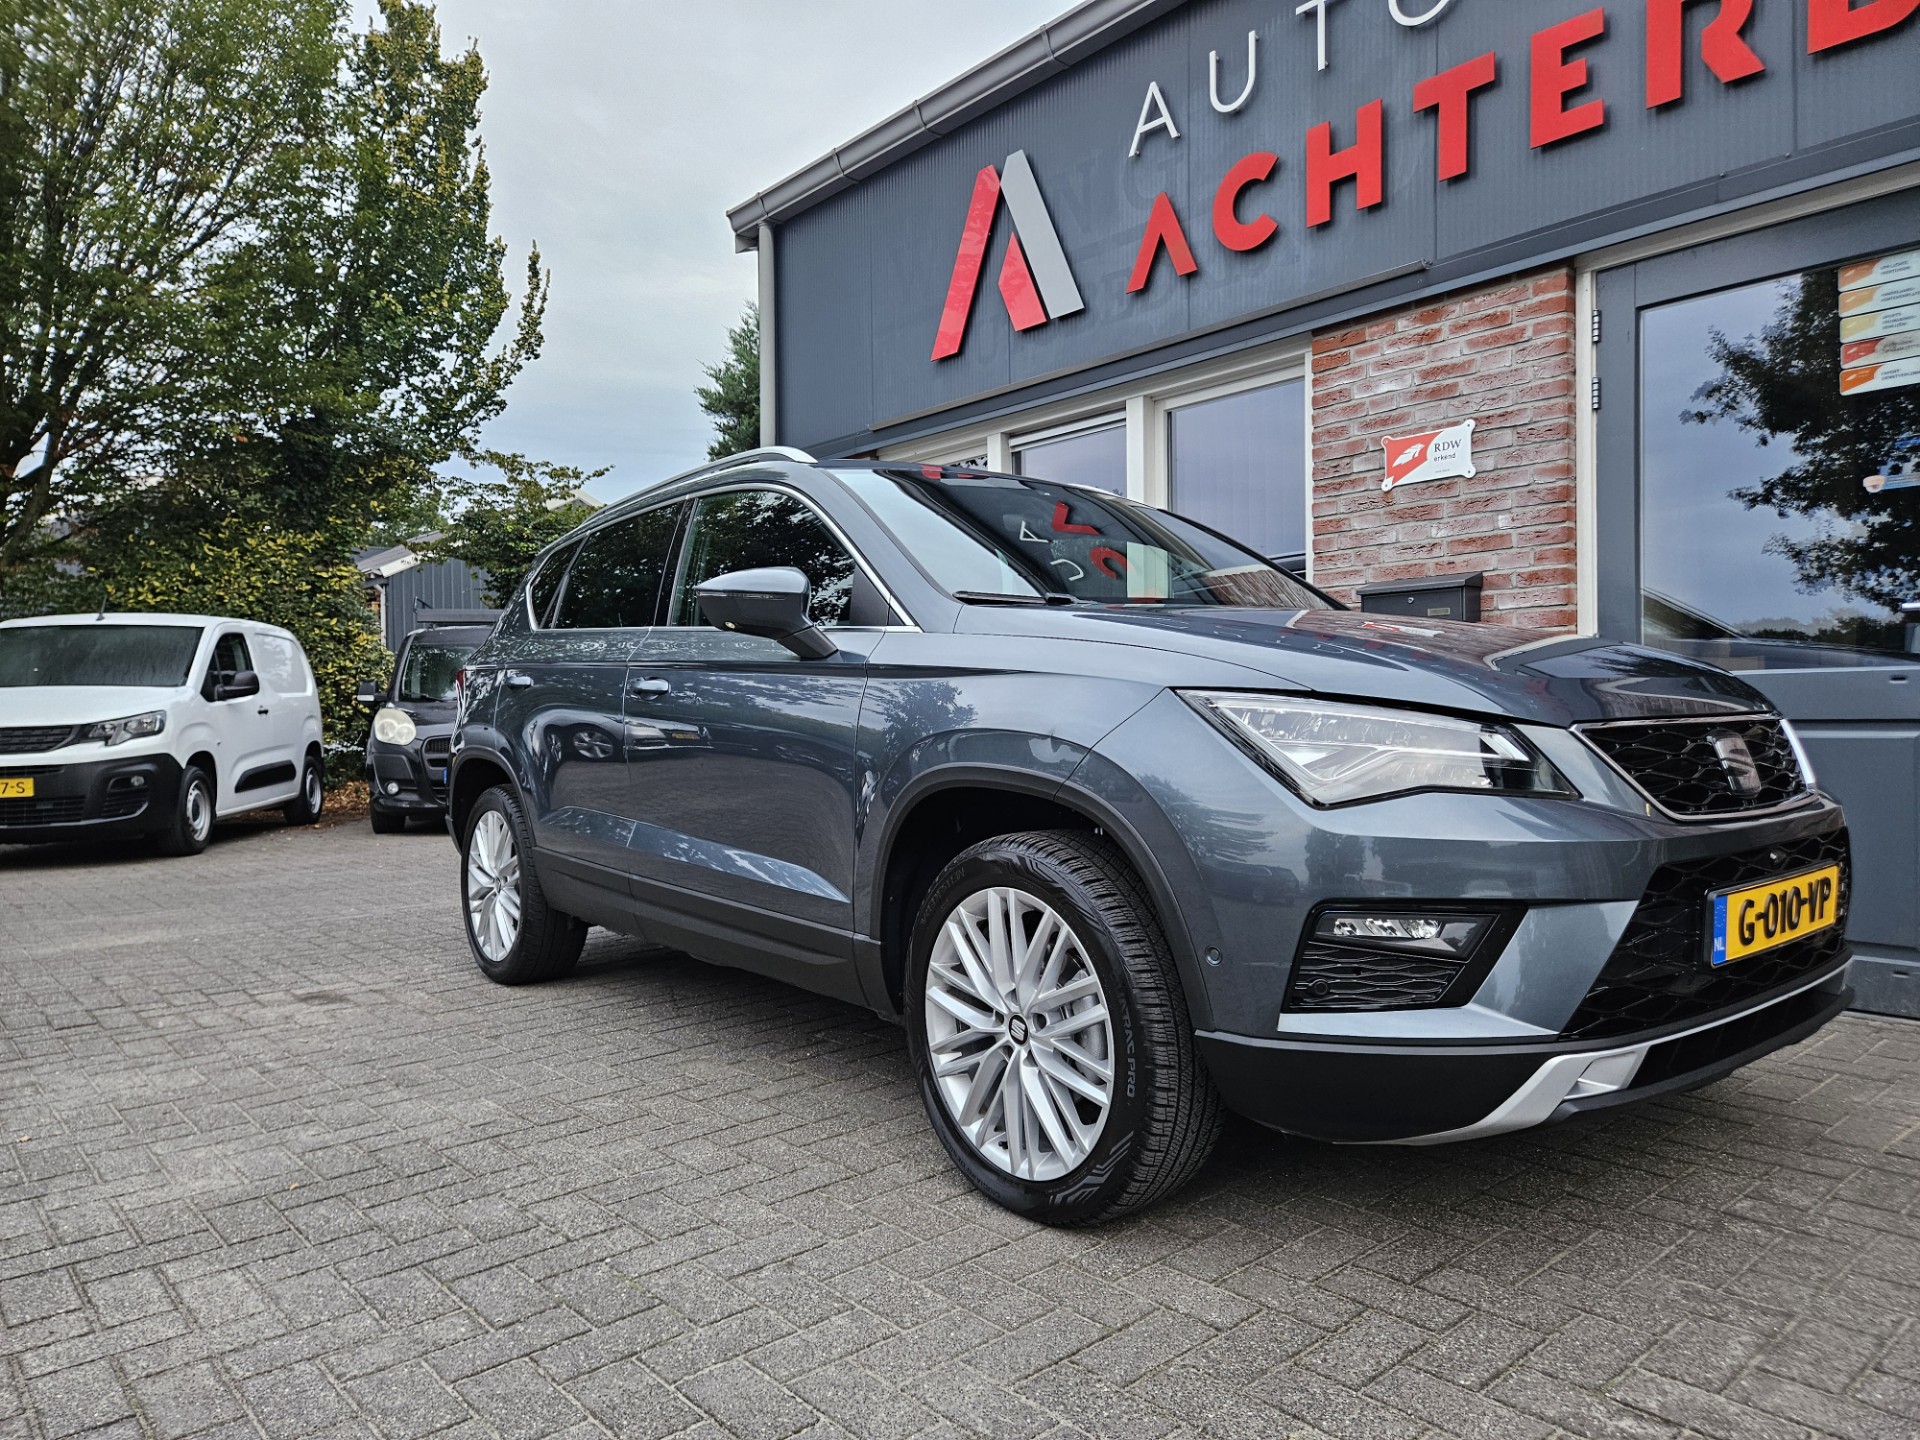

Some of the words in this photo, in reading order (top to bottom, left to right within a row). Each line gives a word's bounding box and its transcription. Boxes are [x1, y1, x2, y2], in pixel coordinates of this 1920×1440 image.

[1434, 439, 1461, 453] RDW
[1434, 453, 1456, 462] erkend
[0, 781, 25, 795] 7-S
[1738, 876, 1832, 946] G-010-VP
[1714, 937, 1725, 952] NL
[1126, 1057, 1136, 1099] PRO
